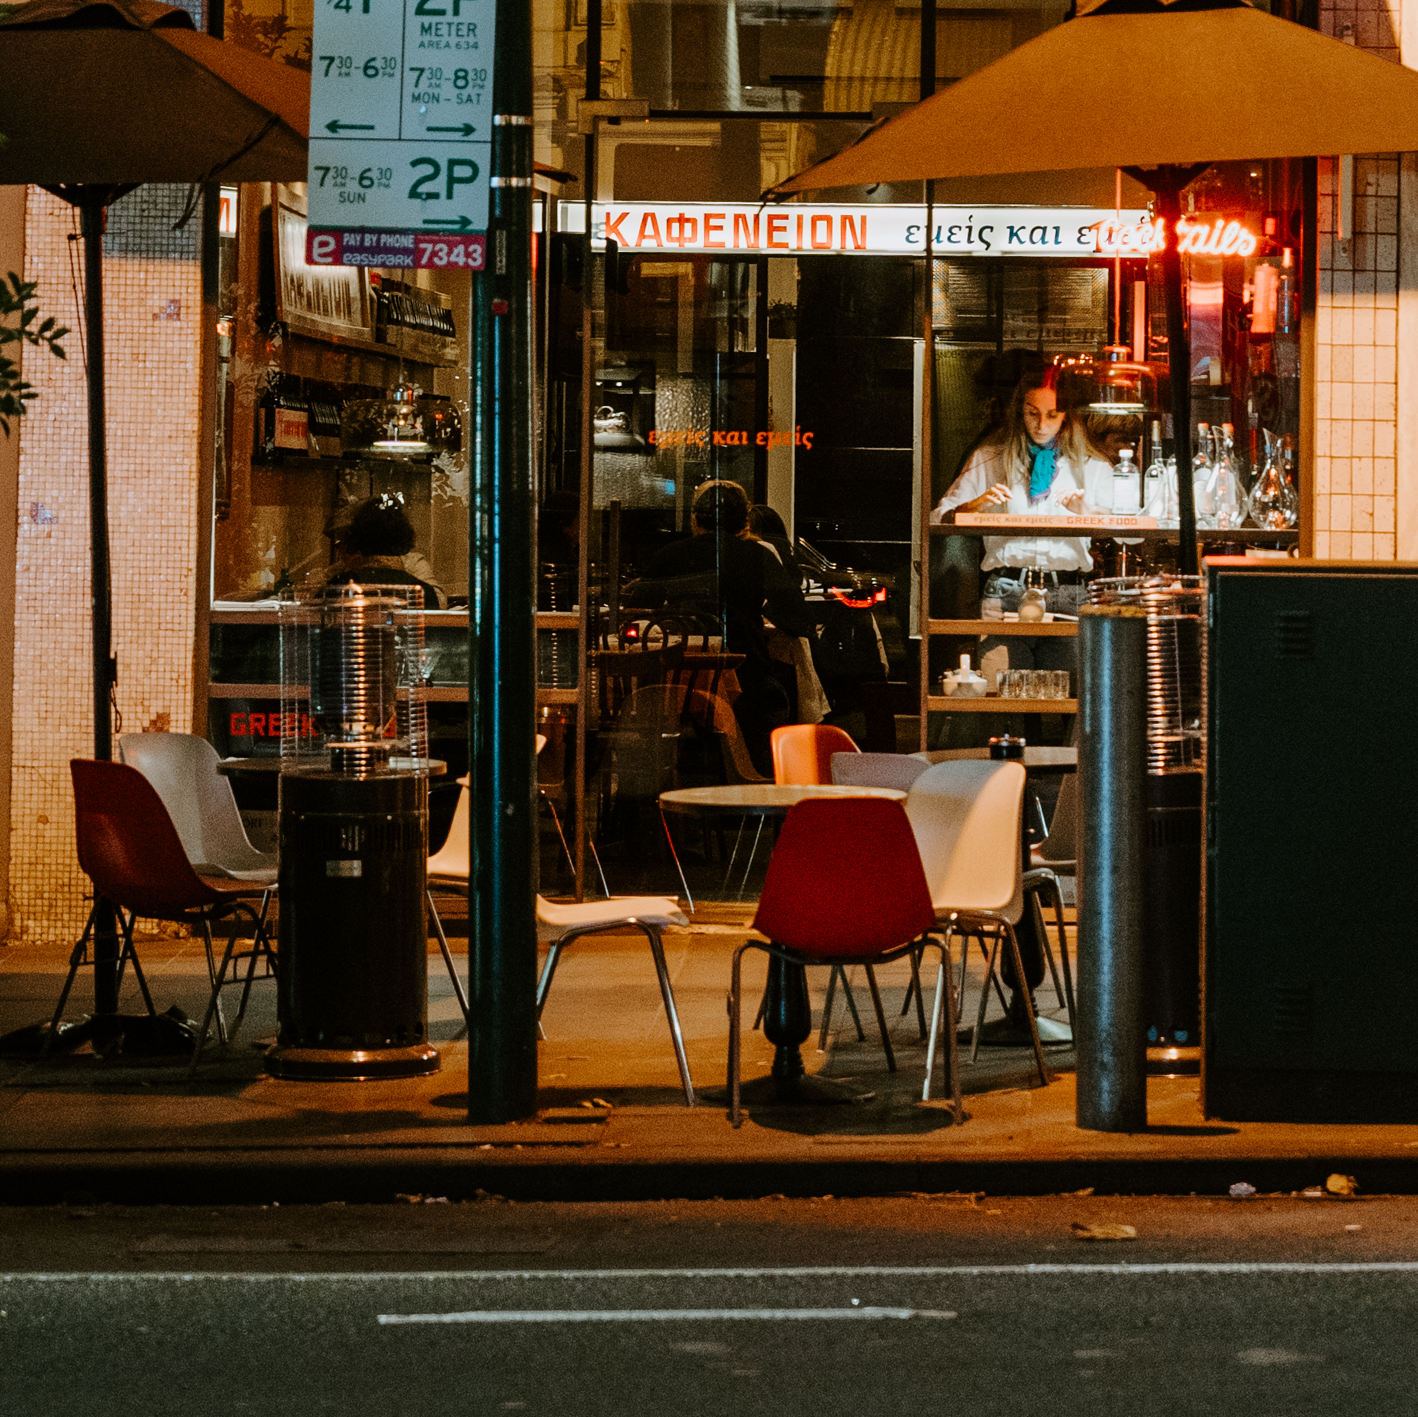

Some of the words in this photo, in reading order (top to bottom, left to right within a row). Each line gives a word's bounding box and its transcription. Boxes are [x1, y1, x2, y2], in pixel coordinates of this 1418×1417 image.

[420, 21, 477, 38] METER
[418, 40, 452, 49] AREA
[455, 40, 479, 50] 634
[411, 91, 440, 104] MON
[456, 93, 482, 105] SAT
[408, 156, 480, 200] 2P
[338, 191, 367, 204] SUN
[343, 233, 362, 246] PAY
[364, 233, 378, 246] BY
[380, 234, 415, 248] PHONE
[1007, 225, 1061, 245] και
[419, 243, 482, 267] 7343
[712, 430, 748, 445] και
[1066, 516, 1105, 525] GREEK
[1108, 517, 1138, 526] FOOD
[229, 712, 319, 737] GREEK
